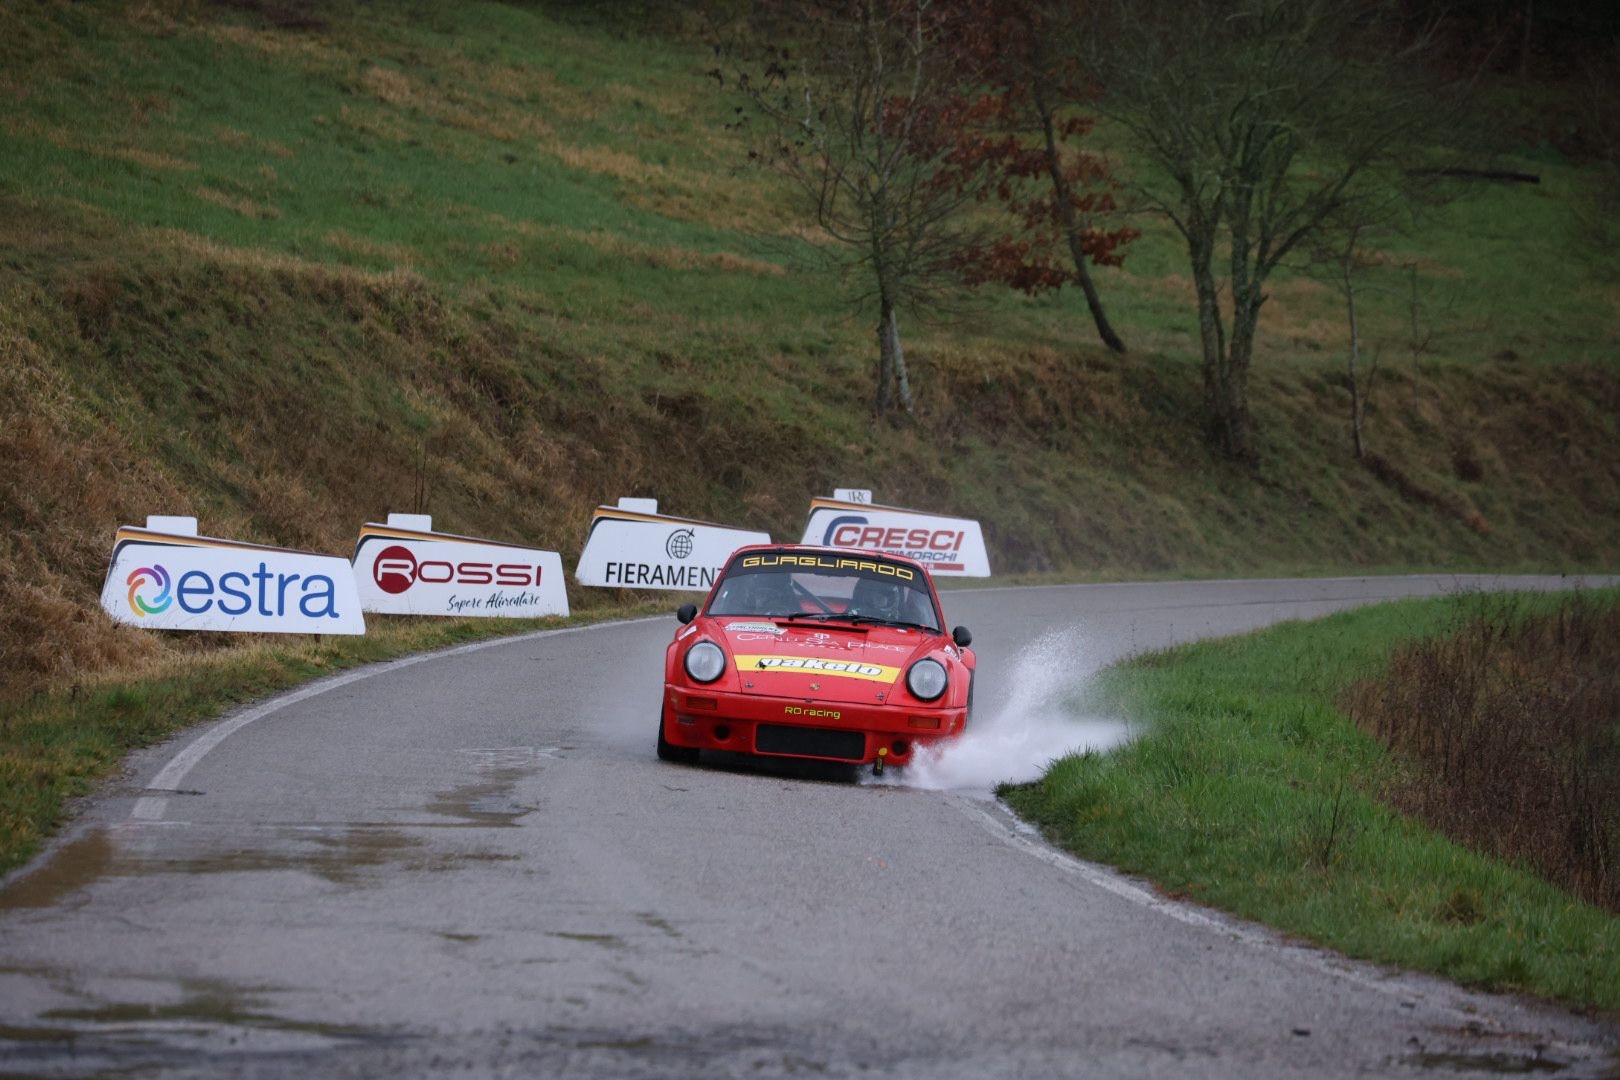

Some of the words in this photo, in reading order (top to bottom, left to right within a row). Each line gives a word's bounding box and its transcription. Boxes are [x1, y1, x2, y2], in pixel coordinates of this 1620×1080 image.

[833, 525, 965, 551] CRESCI
[376, 557, 543, 587] ROSSI
[742, 555, 914, 581] GUAGLIARDO
[176, 562, 340, 619] estra
[485, 590, 541, 609] Alimentare
[755, 657, 883, 677] pakelo
[803, 709, 841, 720] racing
